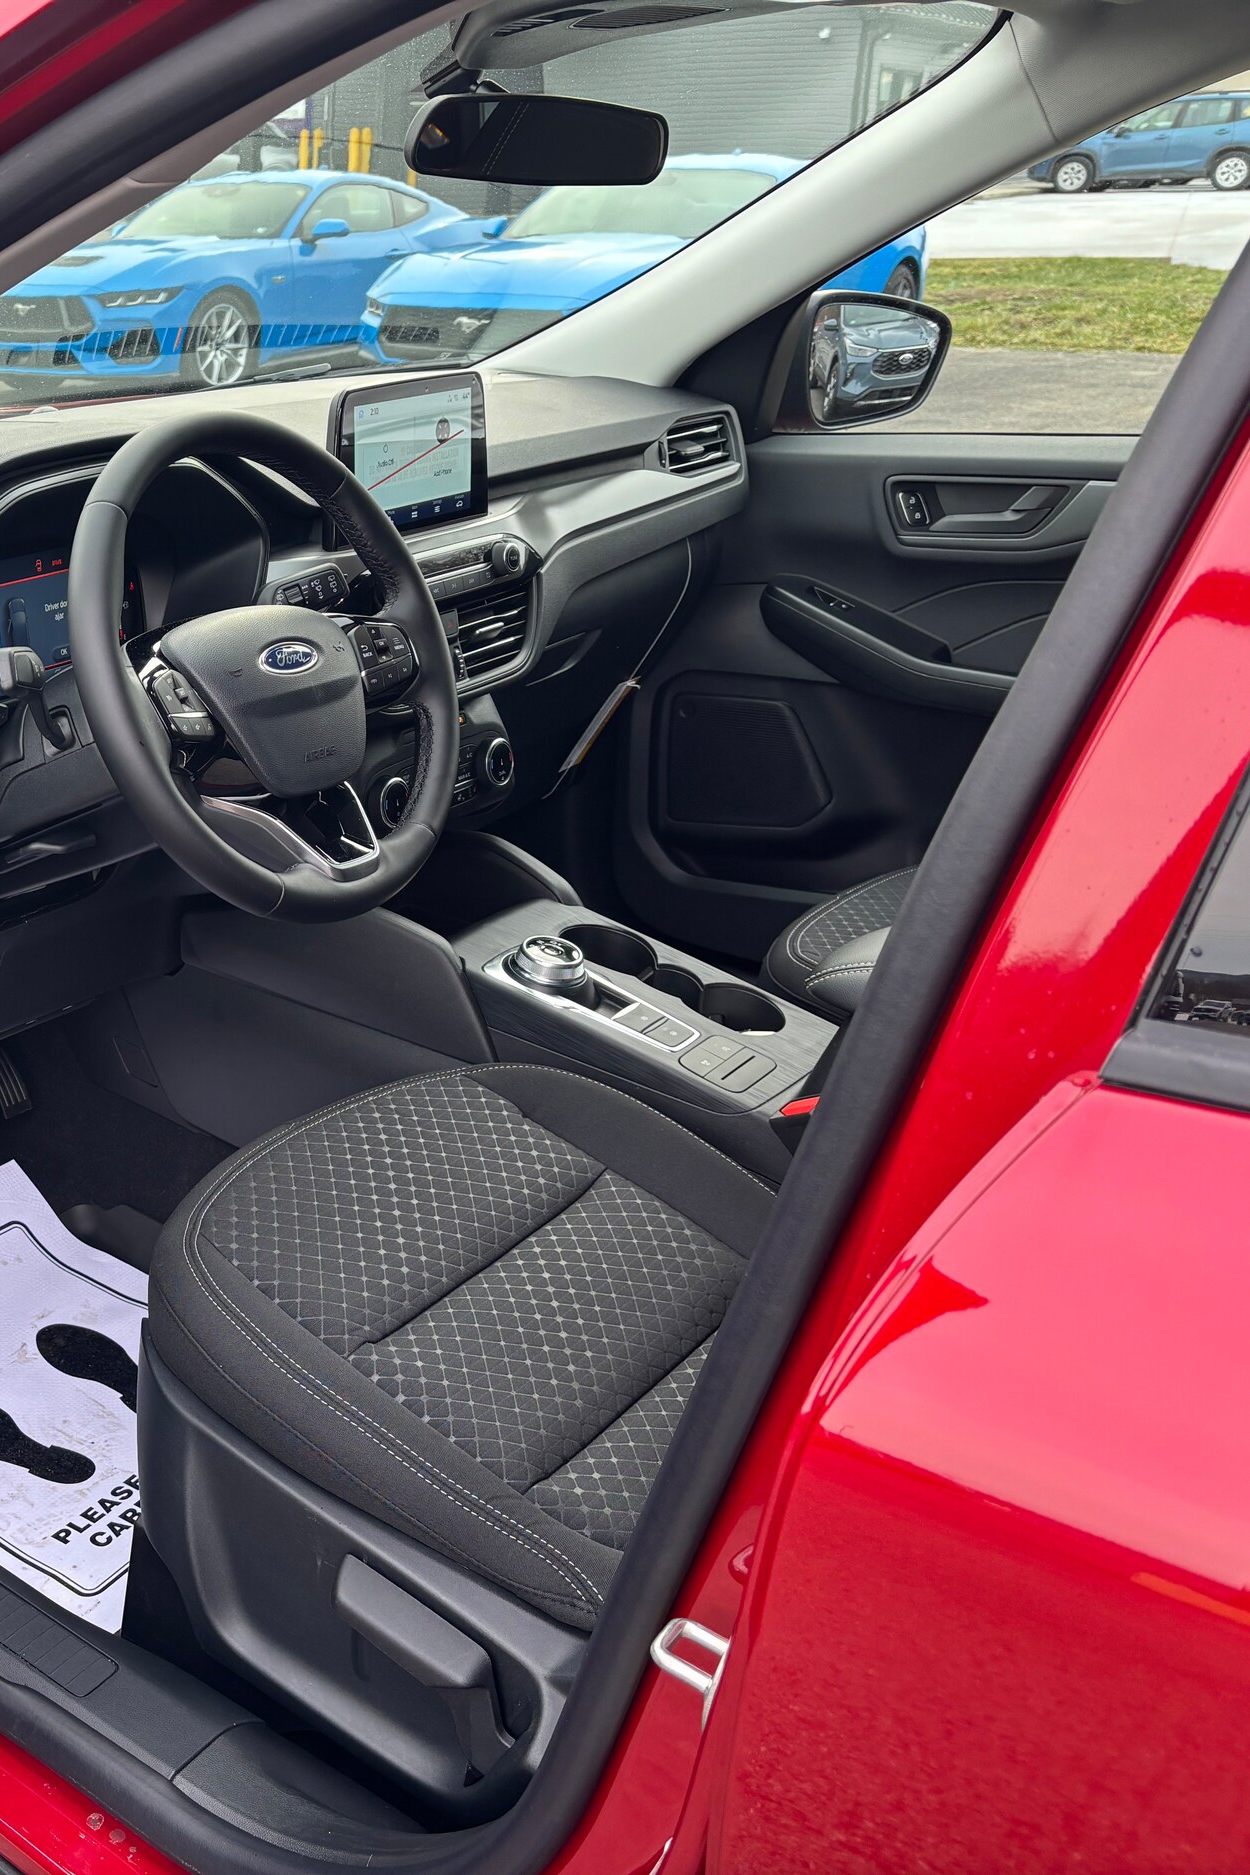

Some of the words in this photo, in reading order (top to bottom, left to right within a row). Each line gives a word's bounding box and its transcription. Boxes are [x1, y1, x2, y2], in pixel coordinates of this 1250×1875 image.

[44, 602, 59, 612] Driver
[54, 612, 65, 621] ajar
[60, 648, 68, 656] OK
[50, 1473, 140, 1545] PLEASE
